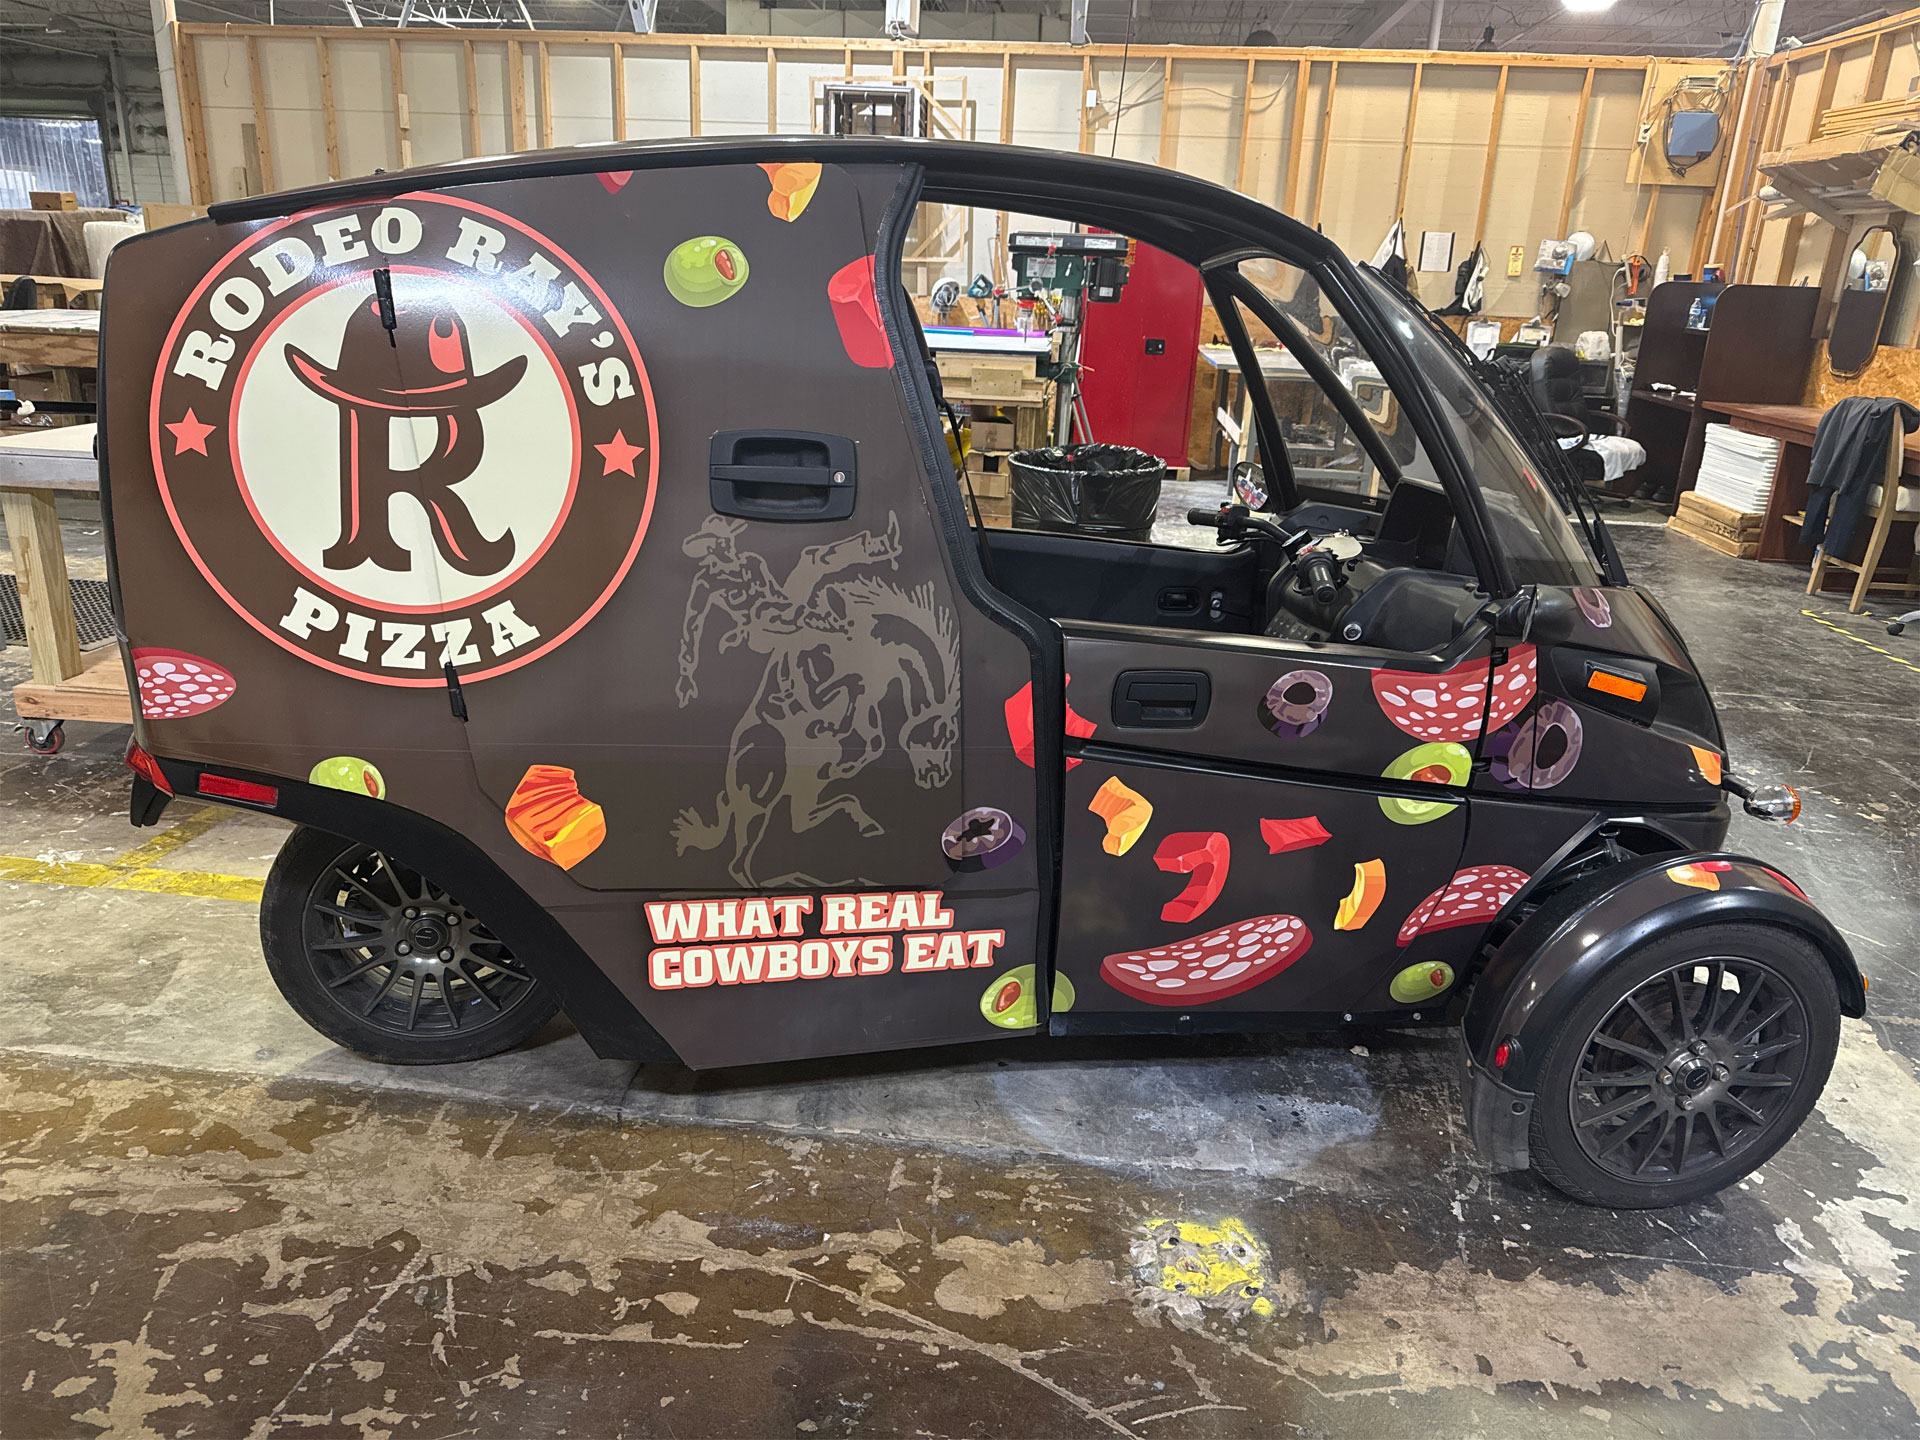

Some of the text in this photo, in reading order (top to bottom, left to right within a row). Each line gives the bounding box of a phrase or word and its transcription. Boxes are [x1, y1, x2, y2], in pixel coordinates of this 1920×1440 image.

[173, 207, 634, 406] RODEO RAY'S
[322, 401, 516, 577] R
[279, 586, 541, 669] PIZZA
[645, 891, 954, 942] WHAT REAL
[649, 930, 1005, 989] COWBOYS EAT
